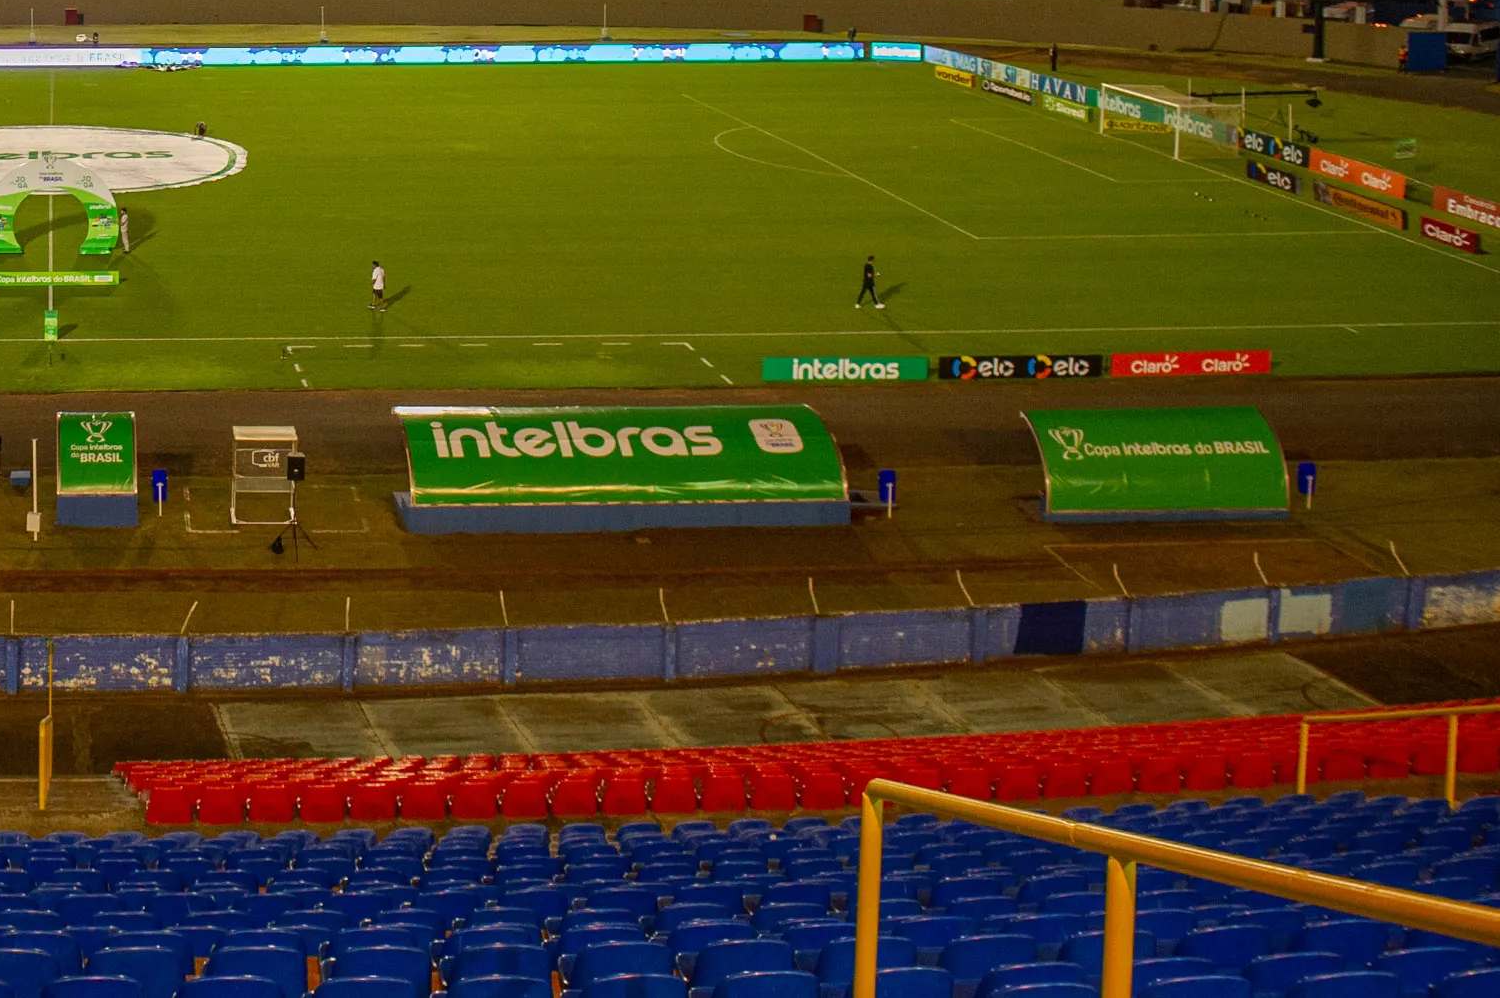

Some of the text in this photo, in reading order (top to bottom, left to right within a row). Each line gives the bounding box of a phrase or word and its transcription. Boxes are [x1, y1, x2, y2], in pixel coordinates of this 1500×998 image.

[1030, 72, 1087, 104] HAVAN
[1320, 159, 1391, 191] Claro Claro
[1424, 223, 1468, 247] Claro
[63, 275, 91, 283] BRASIL
[792, 358, 900, 380] intelbras
[1131, 356, 1247, 374] Claro Claro
[430, 420, 723, 458] intelbras
[80, 452, 123, 463] BRASIL
[262, 452, 280, 463] cbf
[1083, 440, 1270, 459] Copa intelbras do BRASIL
